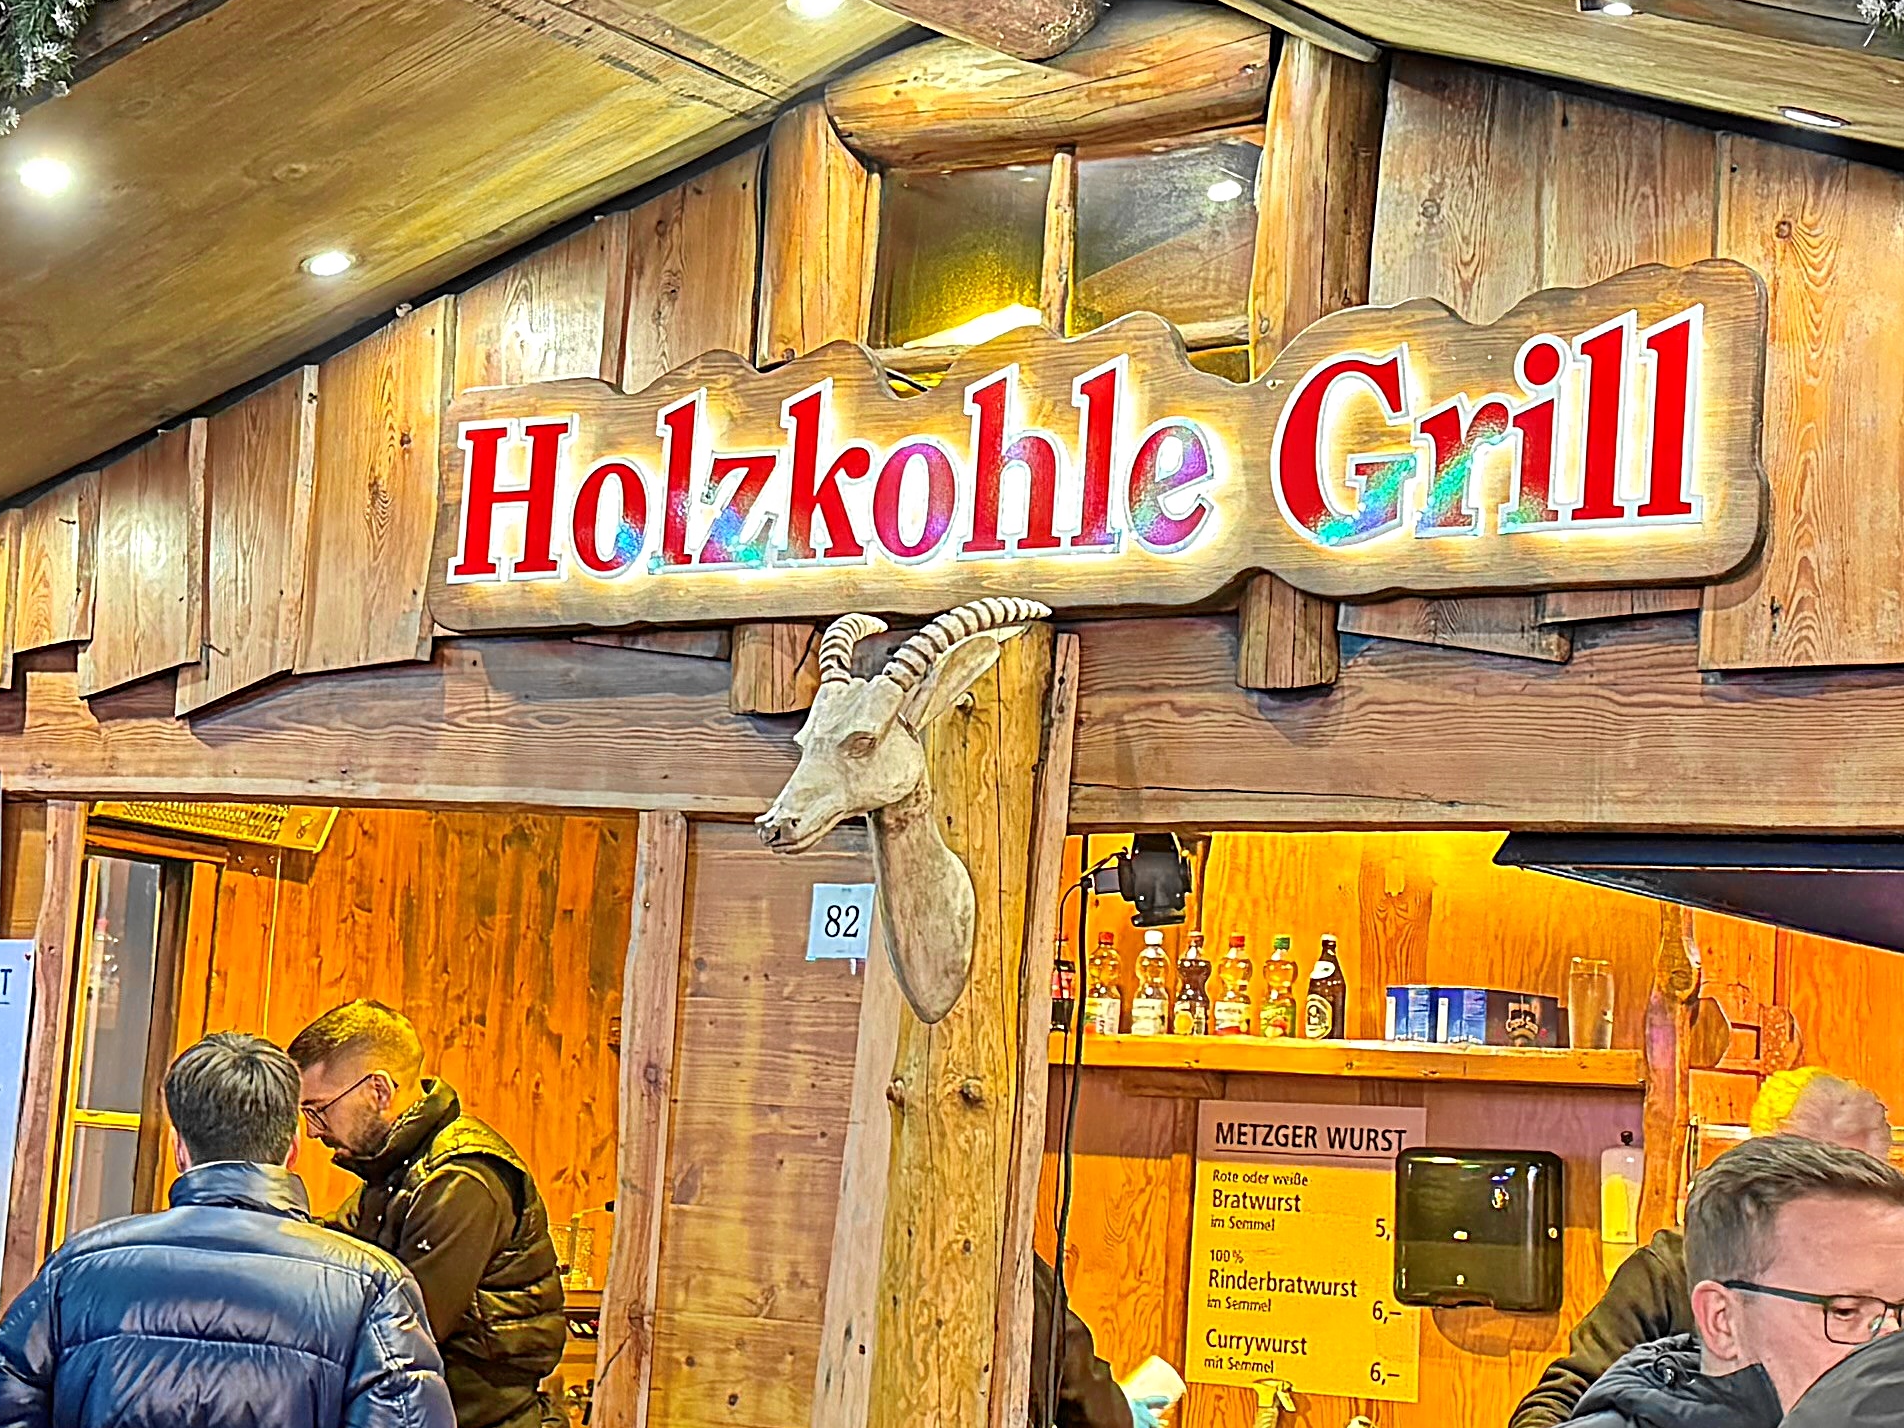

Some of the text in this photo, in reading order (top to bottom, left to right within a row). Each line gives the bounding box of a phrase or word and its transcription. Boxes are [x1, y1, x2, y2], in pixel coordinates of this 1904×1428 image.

[447, 304, 1704, 585] Holzkohle Grill
[825, 905, 860, 938] 82
[1216, 1122, 1407, 1152] METZGER WURST
[1213, 1169, 1308, 1186] Rote oder weiße
[1212, 1189, 1301, 1212] Bratwurst
[1211, 1215, 1390, 1241] im Semmel 5,
[1209, 1269, 1357, 1297] Rinderbratwurst
[1207, 1294, 1221, 1308] im
[1225, 1296, 1271, 1312] Semmel
[1206, 1329, 1307, 1356] Currywurst
[1204, 1356, 1223, 1369] mit
[1228, 1357, 1274, 1373] Semmel
